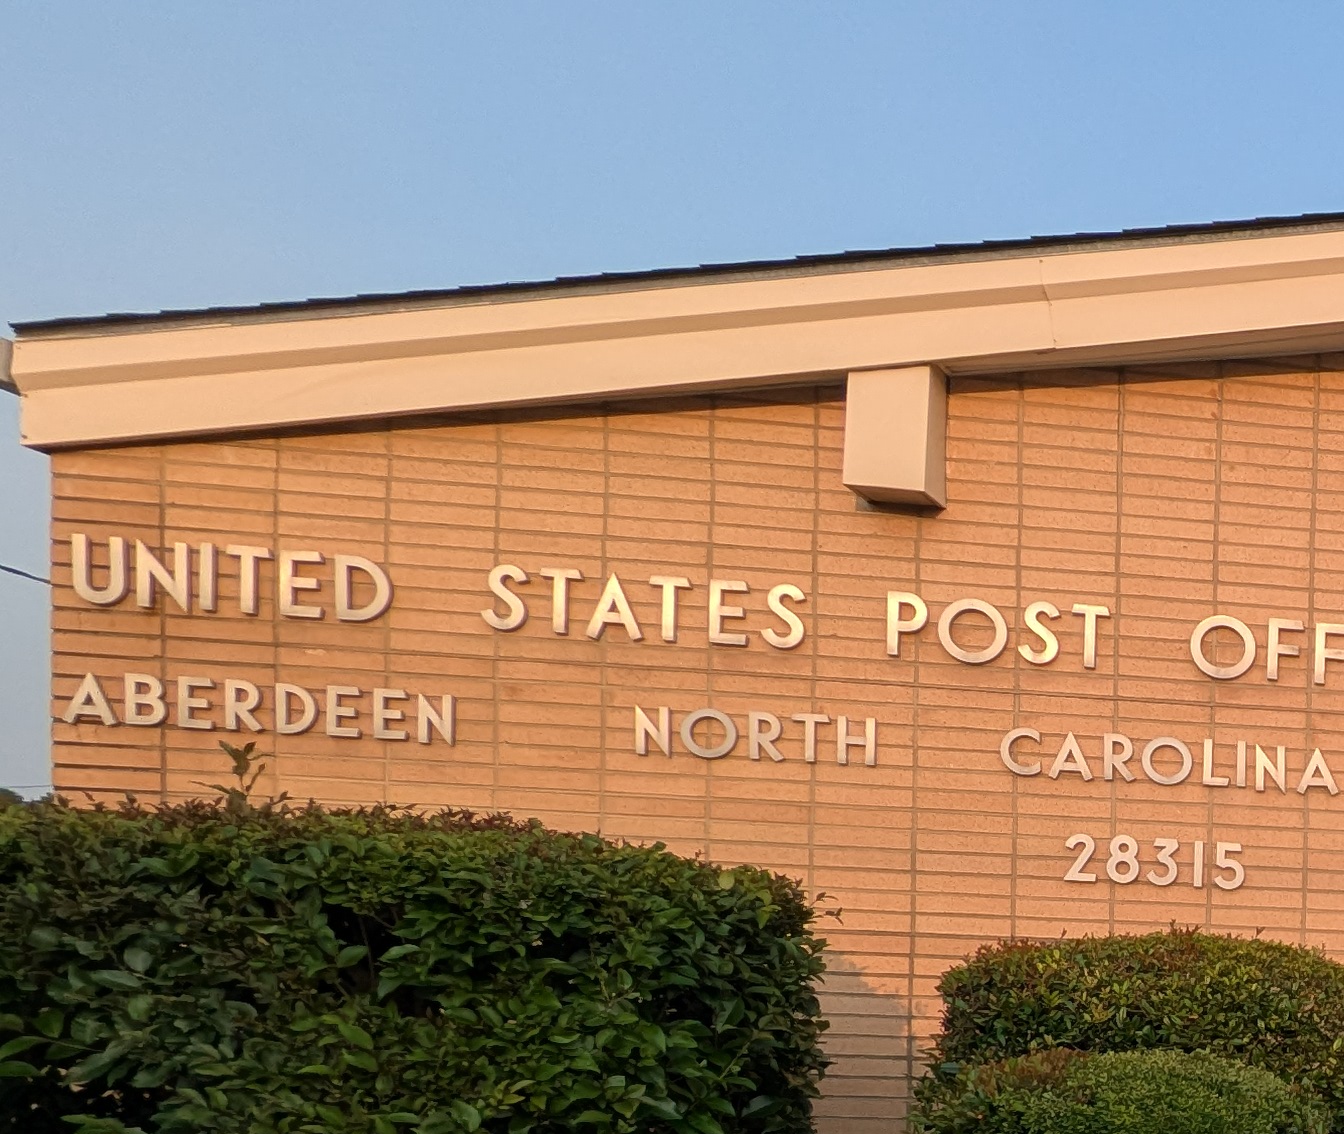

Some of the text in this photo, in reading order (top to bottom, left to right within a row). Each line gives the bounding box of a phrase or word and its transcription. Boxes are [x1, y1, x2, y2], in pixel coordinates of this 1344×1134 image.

[70, 532, 394, 623] UNITED
[479, 563, 807, 651] STATES
[886, 591, 1111, 670] POST
[62, 672, 1340, 796] ABERDEEN NORTH CAROLINA
[1063, 833, 1246, 892] 28315
